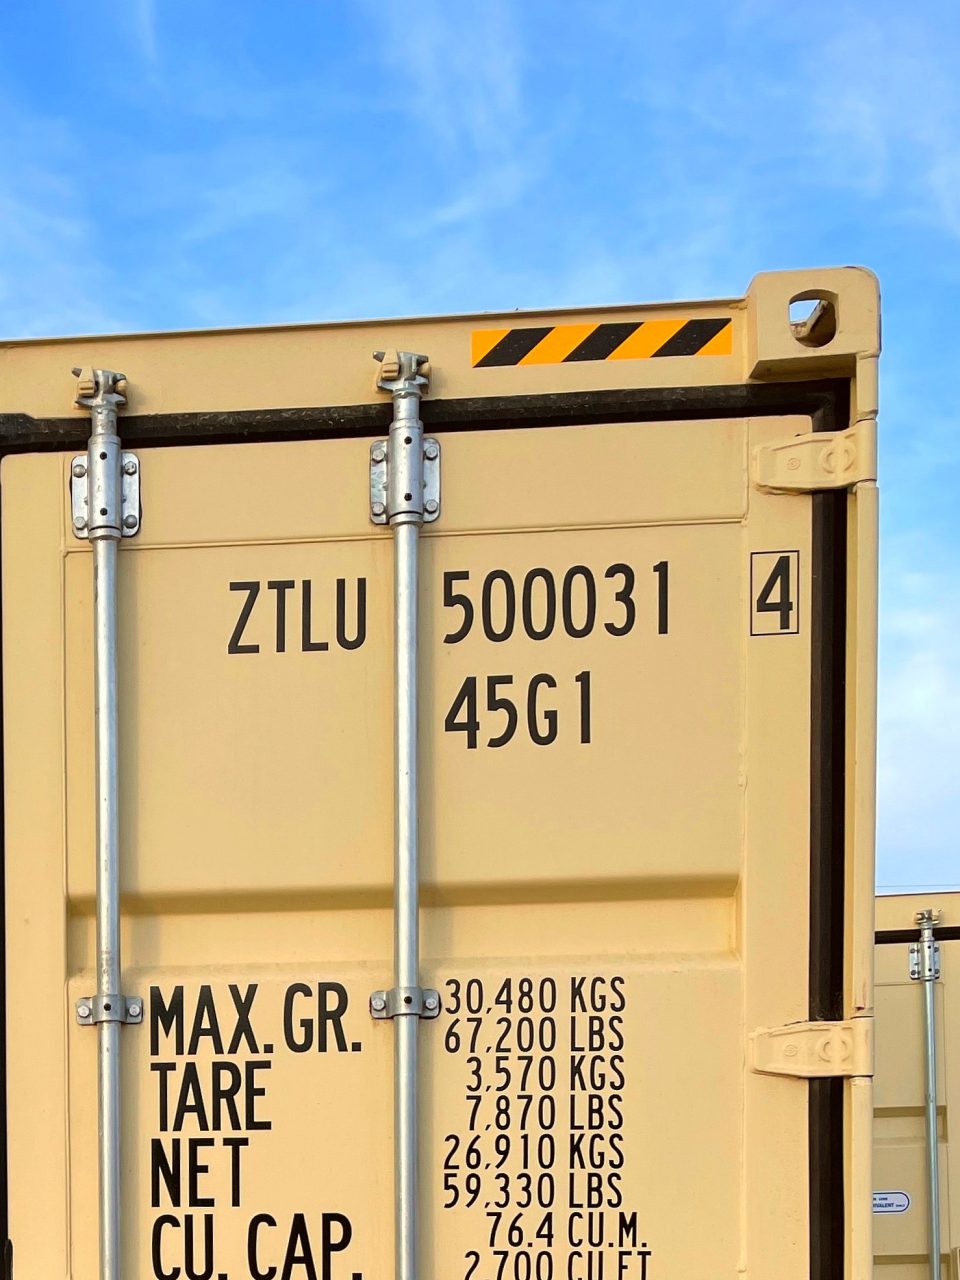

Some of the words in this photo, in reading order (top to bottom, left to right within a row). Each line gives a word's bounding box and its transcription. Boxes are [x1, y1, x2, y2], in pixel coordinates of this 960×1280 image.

[228, 578, 367, 655] ZTLU
[443, 561, 669, 644] 500031
[756, 555, 794, 631] 4
[445, 671, 591, 749] 45G1
[445, 977, 557, 1014] 30,480
[570, 977, 626, 1012] KGS
[445, 1016, 557, 1053] 67,200
[570, 1015, 624, 1052] LBS
[466, 1056, 556, 1092] 3,570
[570, 1055, 625, 1091] KGS
[150, 1060, 272, 1131] TARE
[466, 1094, 556, 1131] 7,870
[569, 1094, 623, 1130] LBS
[444, 1134, 556, 1170] 26,910
[569, 1133, 624, 1169] KGS
[151, 1137, 250, 1208] NET
[443, 1172, 555, 1209] 59,330
[569, 1172, 622, 1209] LBS
[486, 1212, 554, 1248] 76.4
[568, 1212, 648, 1248] CU.M.
